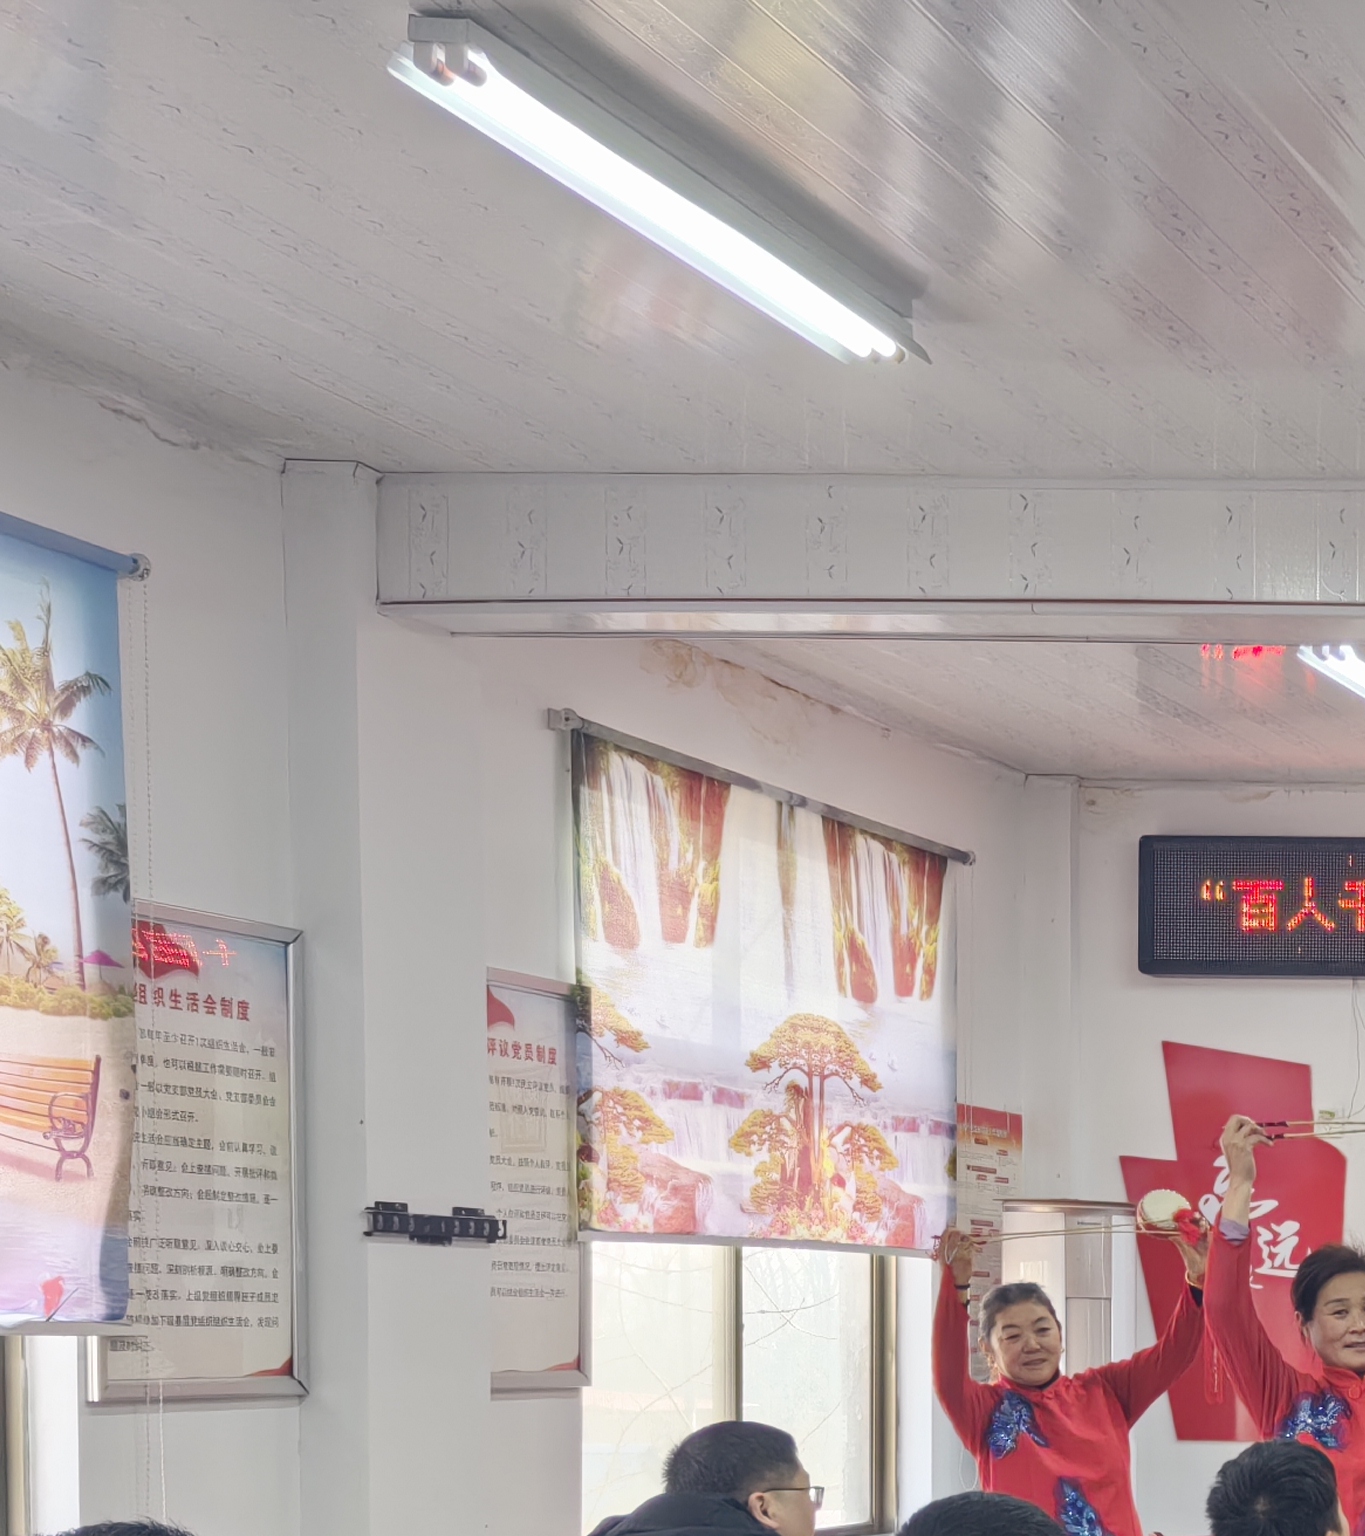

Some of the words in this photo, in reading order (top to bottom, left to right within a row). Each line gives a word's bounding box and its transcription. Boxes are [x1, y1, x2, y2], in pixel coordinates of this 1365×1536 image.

[133, 982, 251, 1022] 组织生活会制度
[487, 1038, 557, 1065] 评议党员制度
